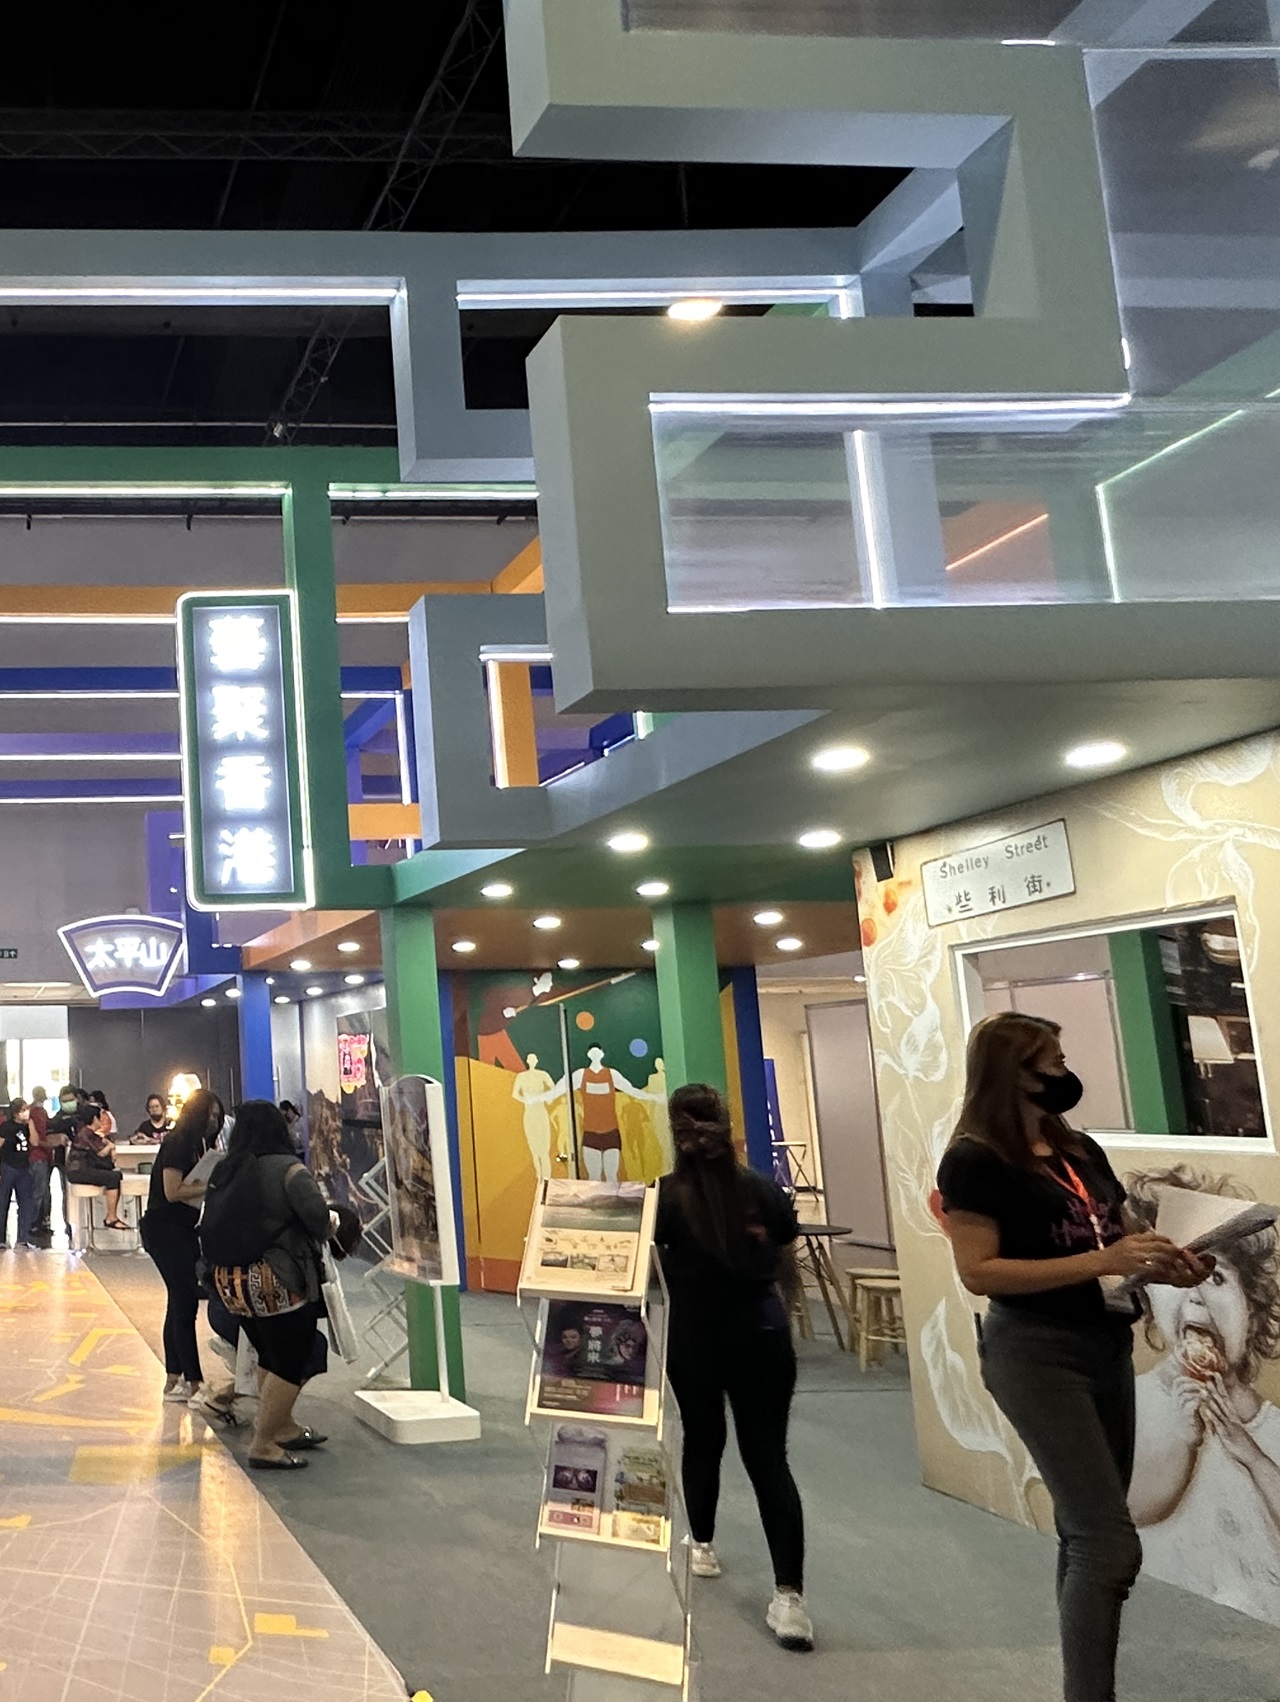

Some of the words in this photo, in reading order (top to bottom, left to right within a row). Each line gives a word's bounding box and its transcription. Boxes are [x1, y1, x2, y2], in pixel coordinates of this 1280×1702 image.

[939, 854, 990, 880] Shelley
[1004, 834, 1049, 861] Street
[954, 874, 1044, 914] 些利街
[83, 935, 169, 970] 太平山
